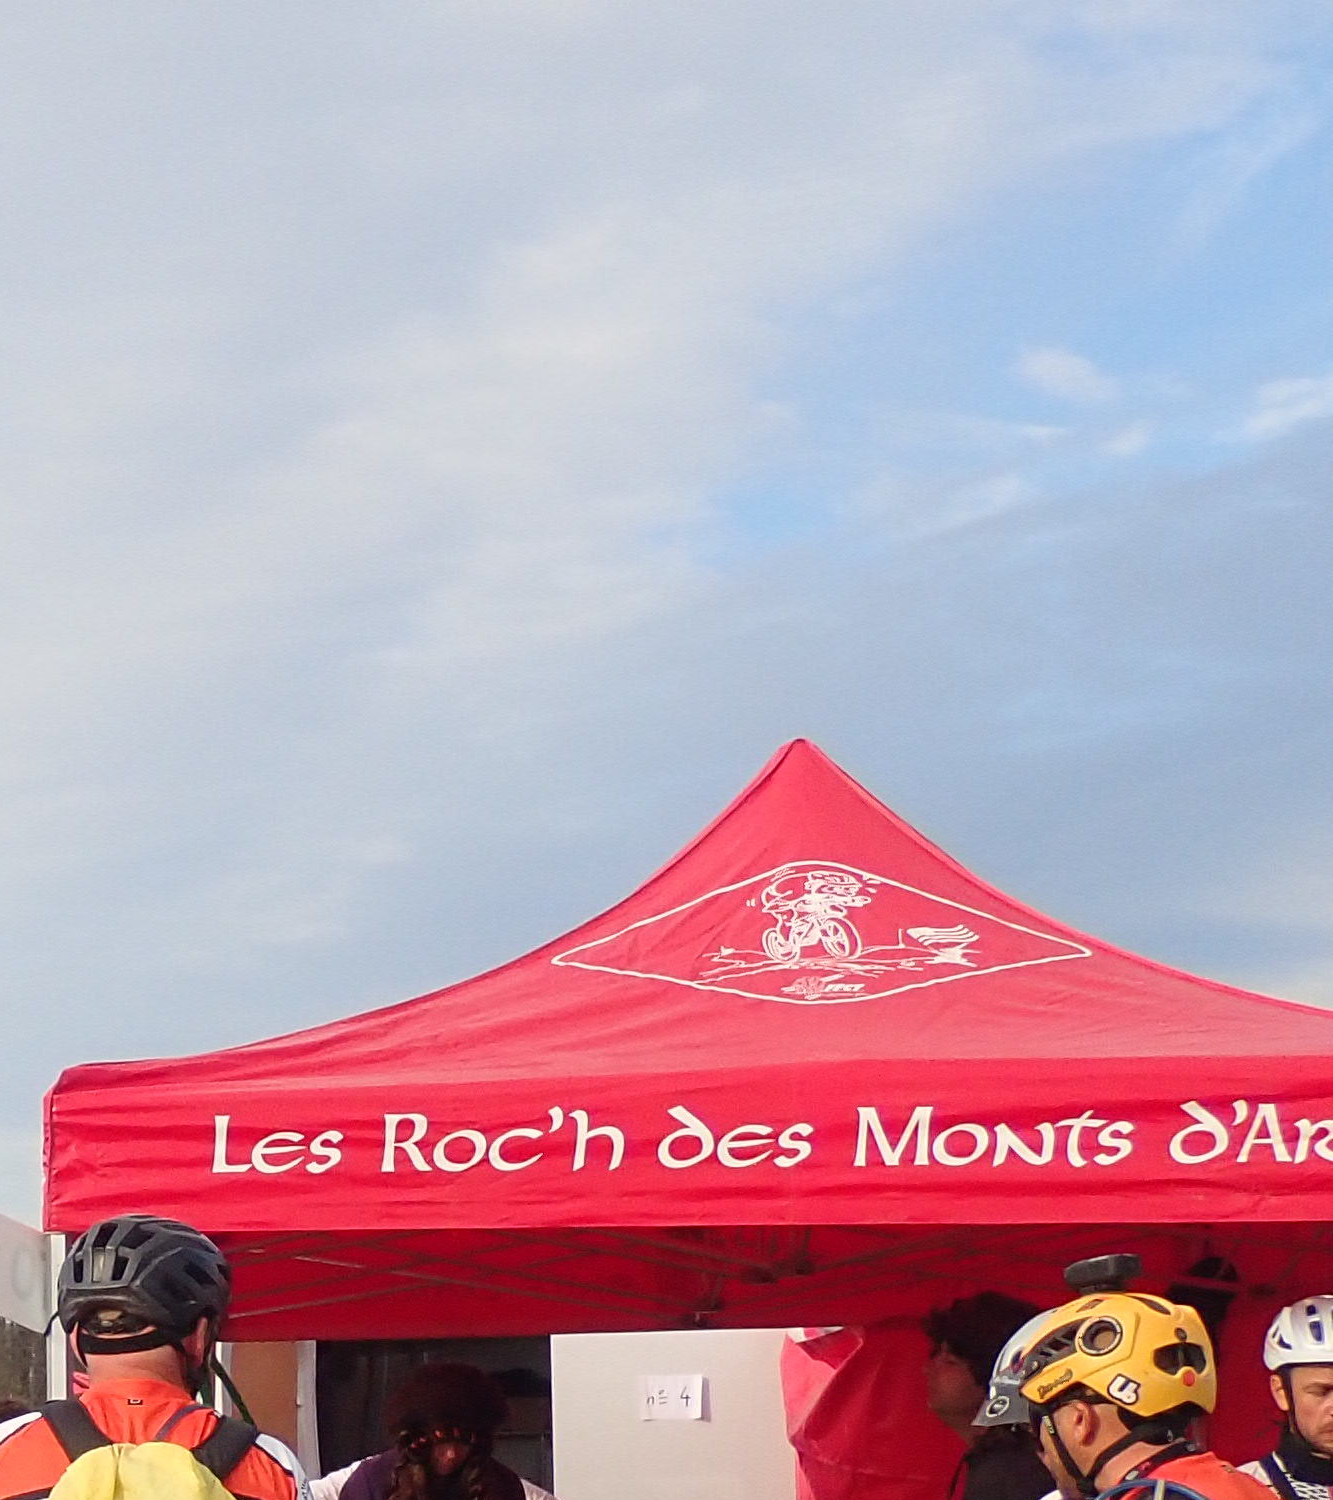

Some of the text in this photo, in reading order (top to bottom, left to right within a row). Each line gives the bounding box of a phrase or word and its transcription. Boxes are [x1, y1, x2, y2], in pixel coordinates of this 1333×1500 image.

[211, 1114, 344, 1174] Les
[656, 1104, 814, 1169] des
[679, 1386, 692, 1408] 4
